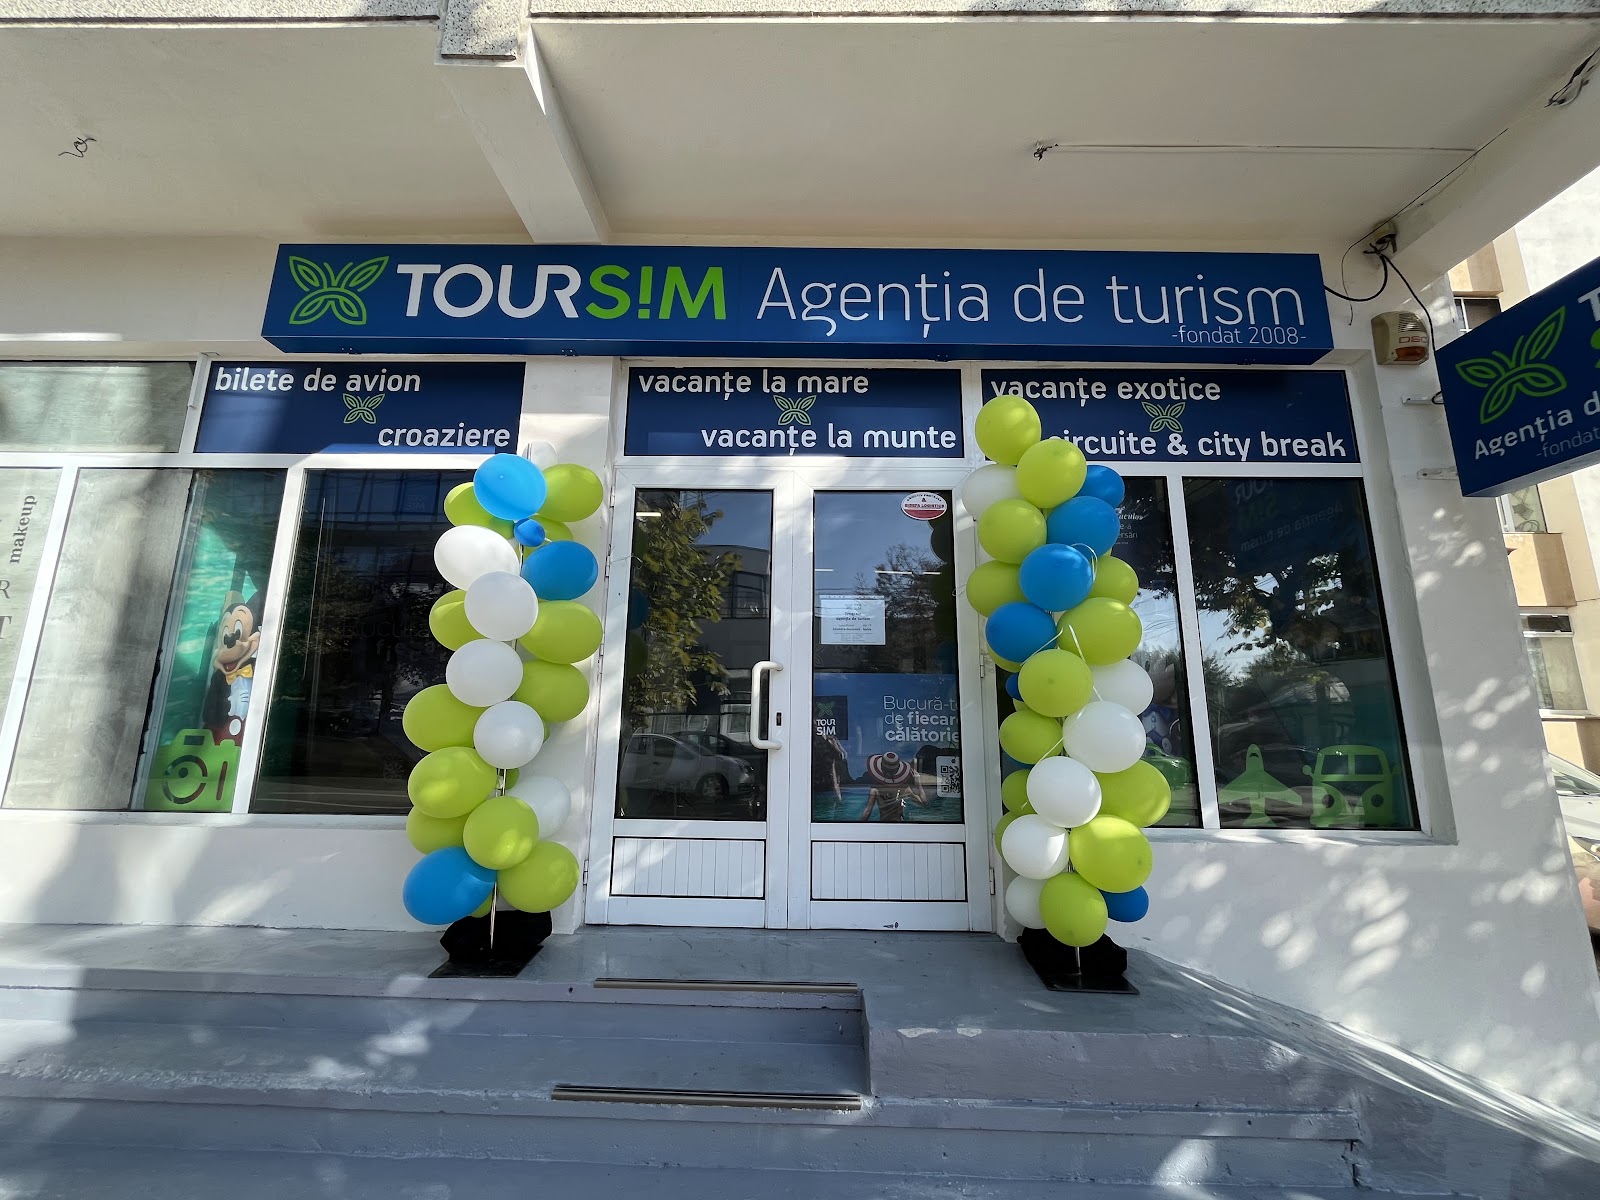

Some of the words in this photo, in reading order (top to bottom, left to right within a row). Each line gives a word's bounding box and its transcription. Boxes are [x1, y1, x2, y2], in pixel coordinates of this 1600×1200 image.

[756, 267, 989, 339] Agenția
[1013, 268, 1085, 323] de
[1105, 274, 1305, 326] turism
[214, 367, 294, 391] bilete
[303, 367, 336, 392] de
[346, 368, 421, 392] avion
[638, 371, 752, 401] vacanțe
[762, 369, 787, 393] la
[797, 376, 869, 393] mare
[990, 377, 1107, 407] vacanțe
[1117, 377, 1221, 401] exotice
[378, 422, 510, 448] croaziere
[701, 425, 817, 457] vacanțe
[828, 423, 852, 448] la
[863, 425, 956, 449] munte
[1475, 409, 1573, 460] Agenția
[1584, 390, 1600, 415] d
[1168, 433, 1188, 456] &
[1199, 431, 1251, 461] city
[1260, 431, 1347, 457] break
[9, 494, 37, 564] makeup
[883, 695, 958, 711] Bucură-t
[884, 711, 904, 725] de
[907, 711, 958, 725] fiecar
[816, 718, 836, 727] TOUR
